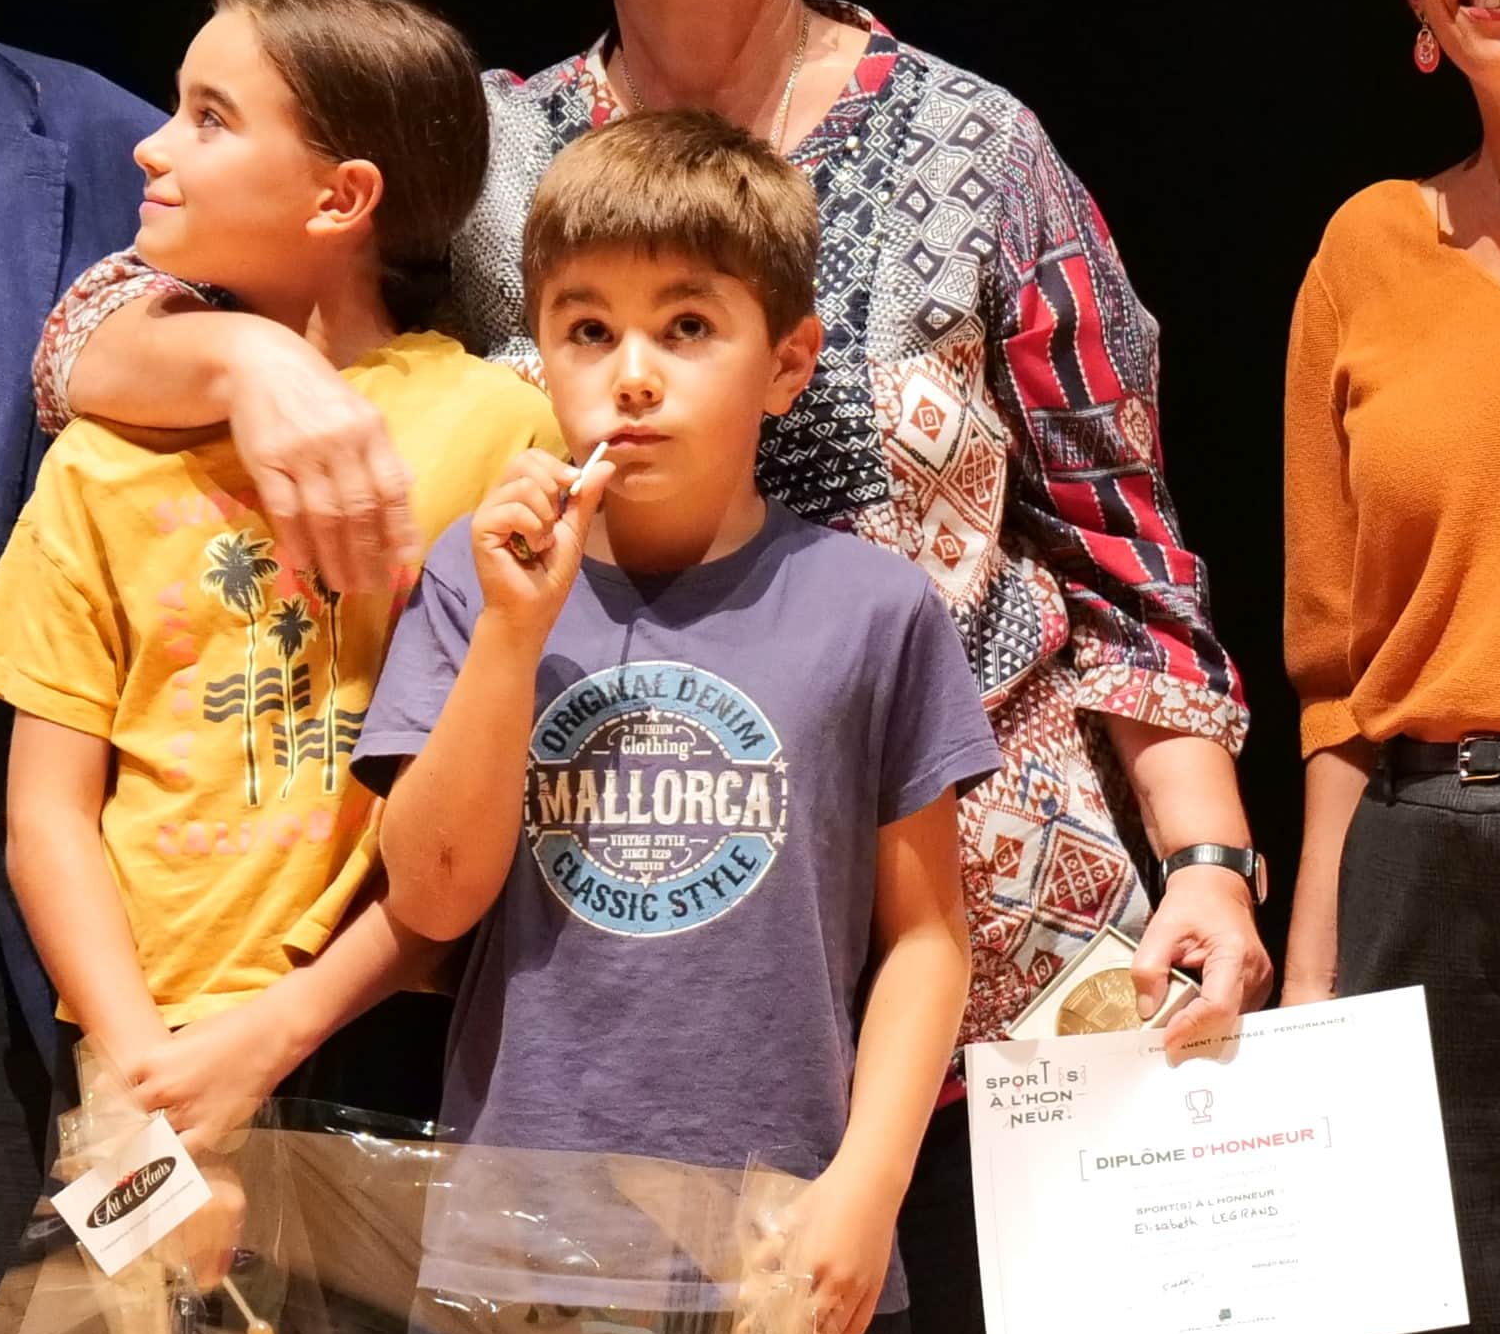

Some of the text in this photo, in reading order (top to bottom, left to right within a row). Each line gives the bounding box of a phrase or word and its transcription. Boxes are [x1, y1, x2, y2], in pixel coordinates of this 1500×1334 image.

[541, 673, 766, 755] ORIGINAL DENIM
[621, 734, 690, 760] Clothing
[536, 769, 772, 828] MALLORCA
[610, 834, 686, 846] VINTAGE STYLE
[622, 848, 648, 859] SINCE
[552, 845, 757, 922] CLASSIC STYLE
[986, 1060, 1050, 1090] SPORT
[990, 1093, 1003, 1107] À
[1096, 1128, 1315, 1171] DIPLÔME D'HONNEUR
[1212, 1205, 1279, 1225] LEGRAND
